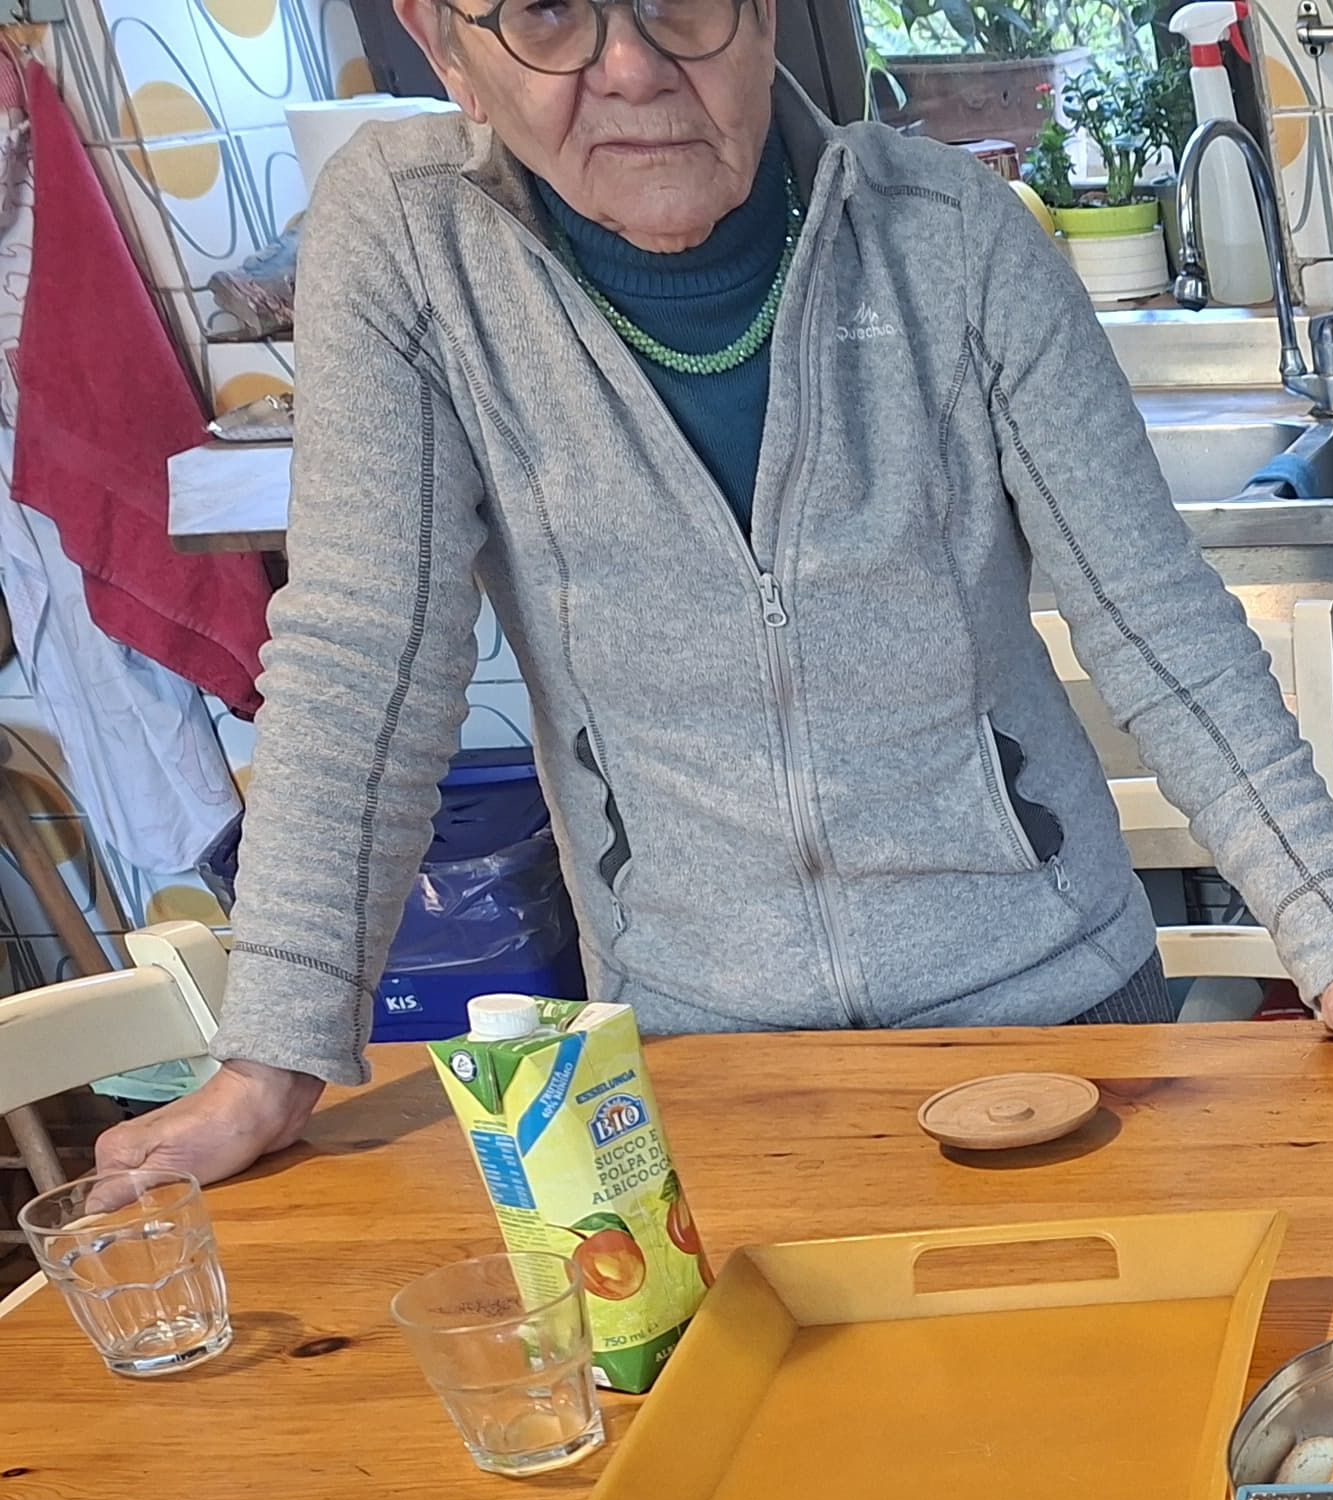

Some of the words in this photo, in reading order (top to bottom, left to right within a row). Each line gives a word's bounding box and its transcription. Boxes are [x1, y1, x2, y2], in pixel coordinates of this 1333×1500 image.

[836, 323, 896, 341] Quechua
[385, 995, 417, 1011] KIS
[595, 1104, 641, 1142] BIO
[594, 1135, 646, 1171] SUCCO
[648, 1129, 659, 1142] E
[600, 1153, 647, 1186] POLPA
[648, 1142, 664, 1162] DI
[602, 1335, 627, 1348] 750
